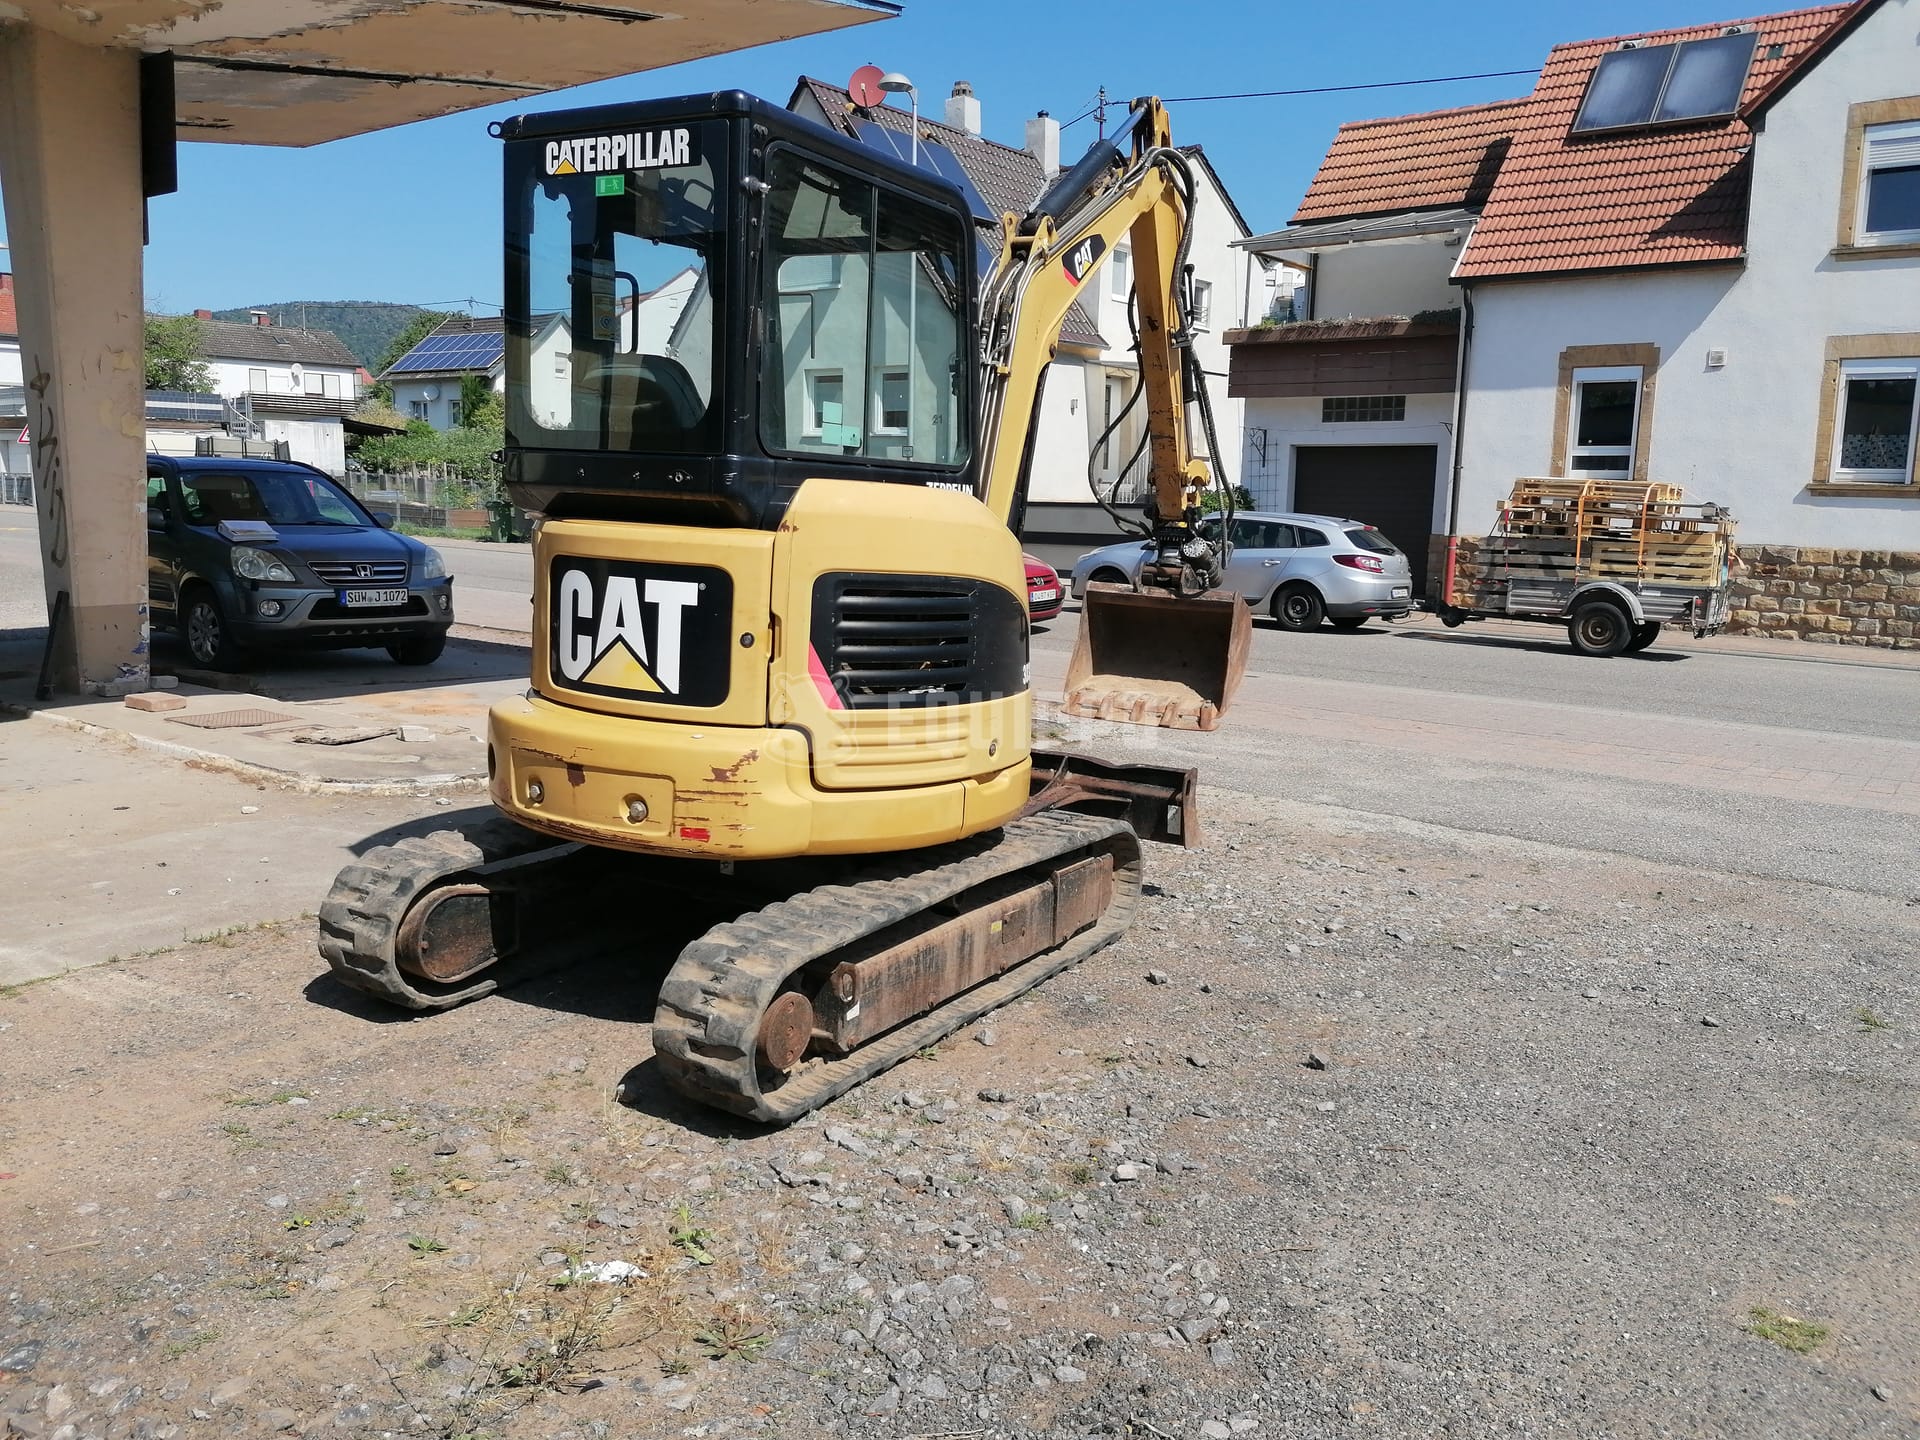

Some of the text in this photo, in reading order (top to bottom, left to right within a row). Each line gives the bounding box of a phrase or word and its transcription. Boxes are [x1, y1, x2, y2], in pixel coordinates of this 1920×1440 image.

[545, 128, 690, 175] CATERPILLAR
[1074, 238, 1093, 279] CAT
[374, 591, 381, 602] J
[383, 590, 407, 602] 1072
[559, 569, 699, 695] CAT
